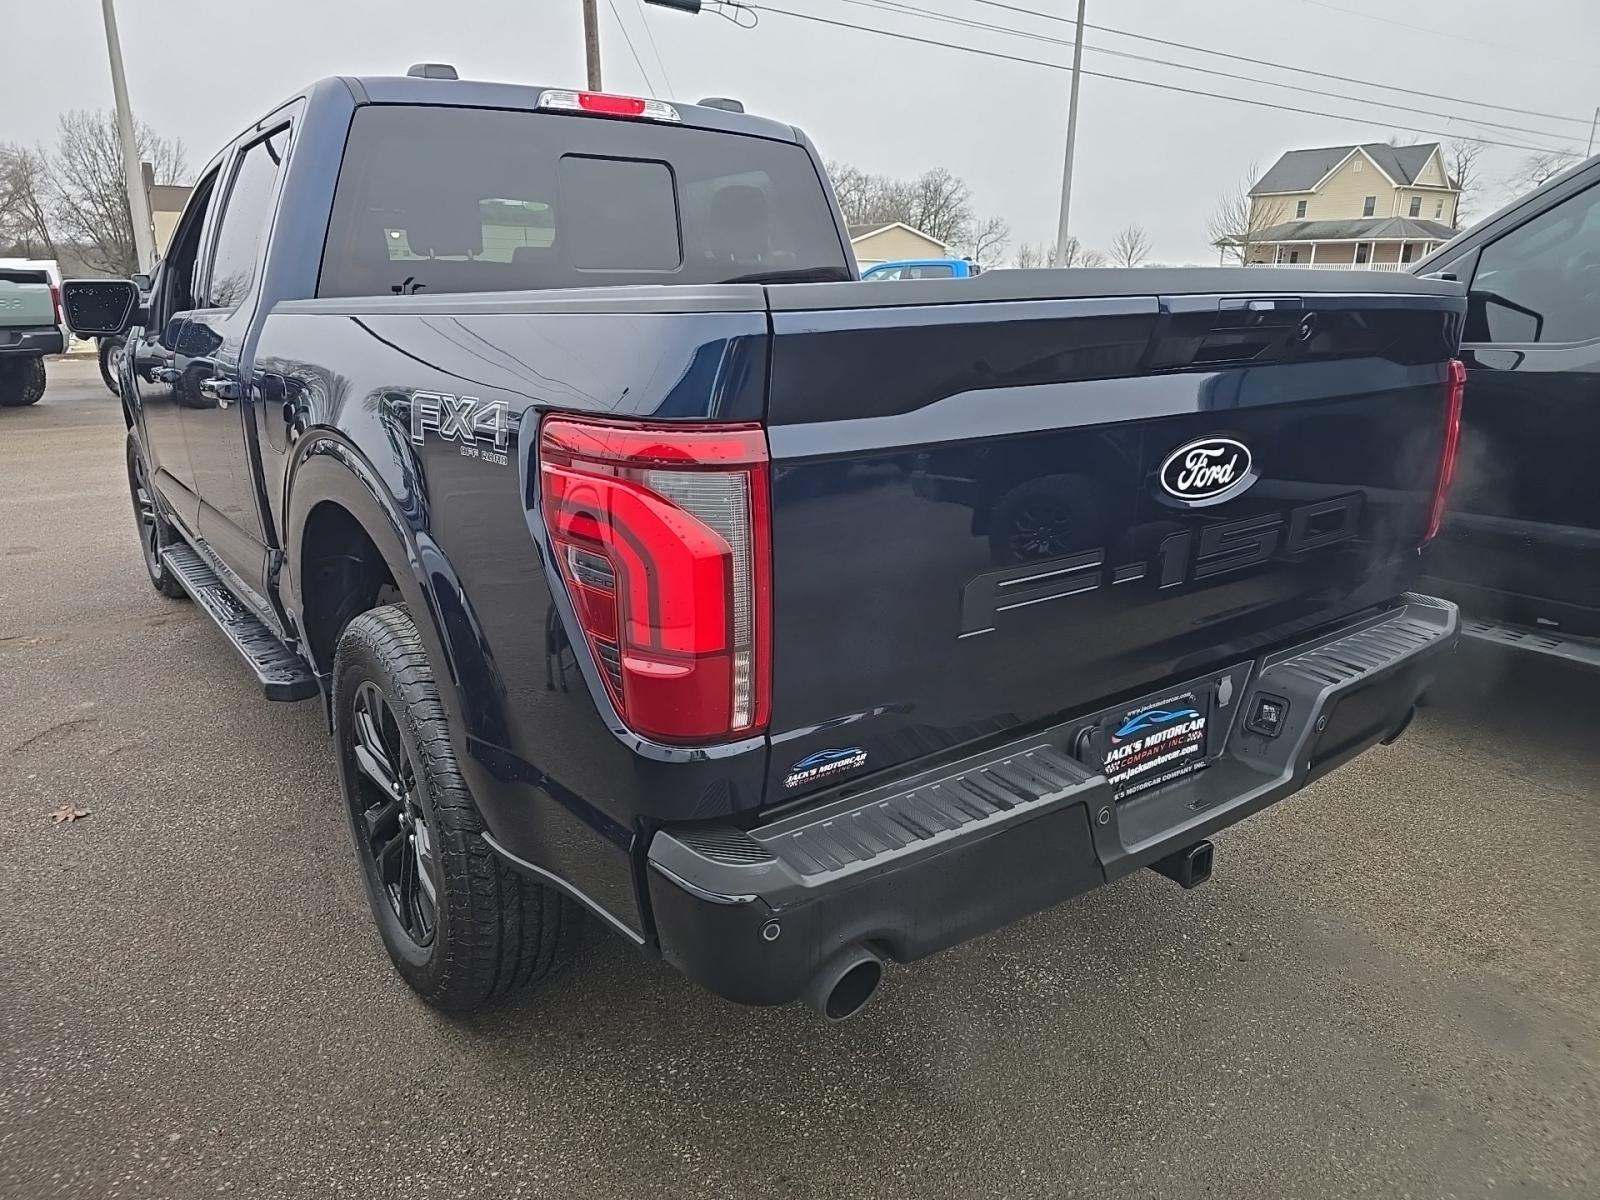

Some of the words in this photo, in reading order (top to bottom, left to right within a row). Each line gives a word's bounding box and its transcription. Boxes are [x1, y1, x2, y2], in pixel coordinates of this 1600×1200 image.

[411, 390, 509, 453] FX4
[1177, 448, 1235, 490] Ford
[959, 490, 1367, 638] F-150
[1104, 739, 1143, 764] JACK'S
[1144, 718, 1205, 748] MOTORCAR
[1121, 744, 1166, 767] COMPANY
[786, 768, 817, 783] JACK'S
[819, 753, 867, 773] MOTORCAR
[1108, 744, 1198, 785] www.jacksmotorcar.com
[1126, 777, 1161, 796] MOTORCAR
[1162, 766, 1193, 782] COMPANY
